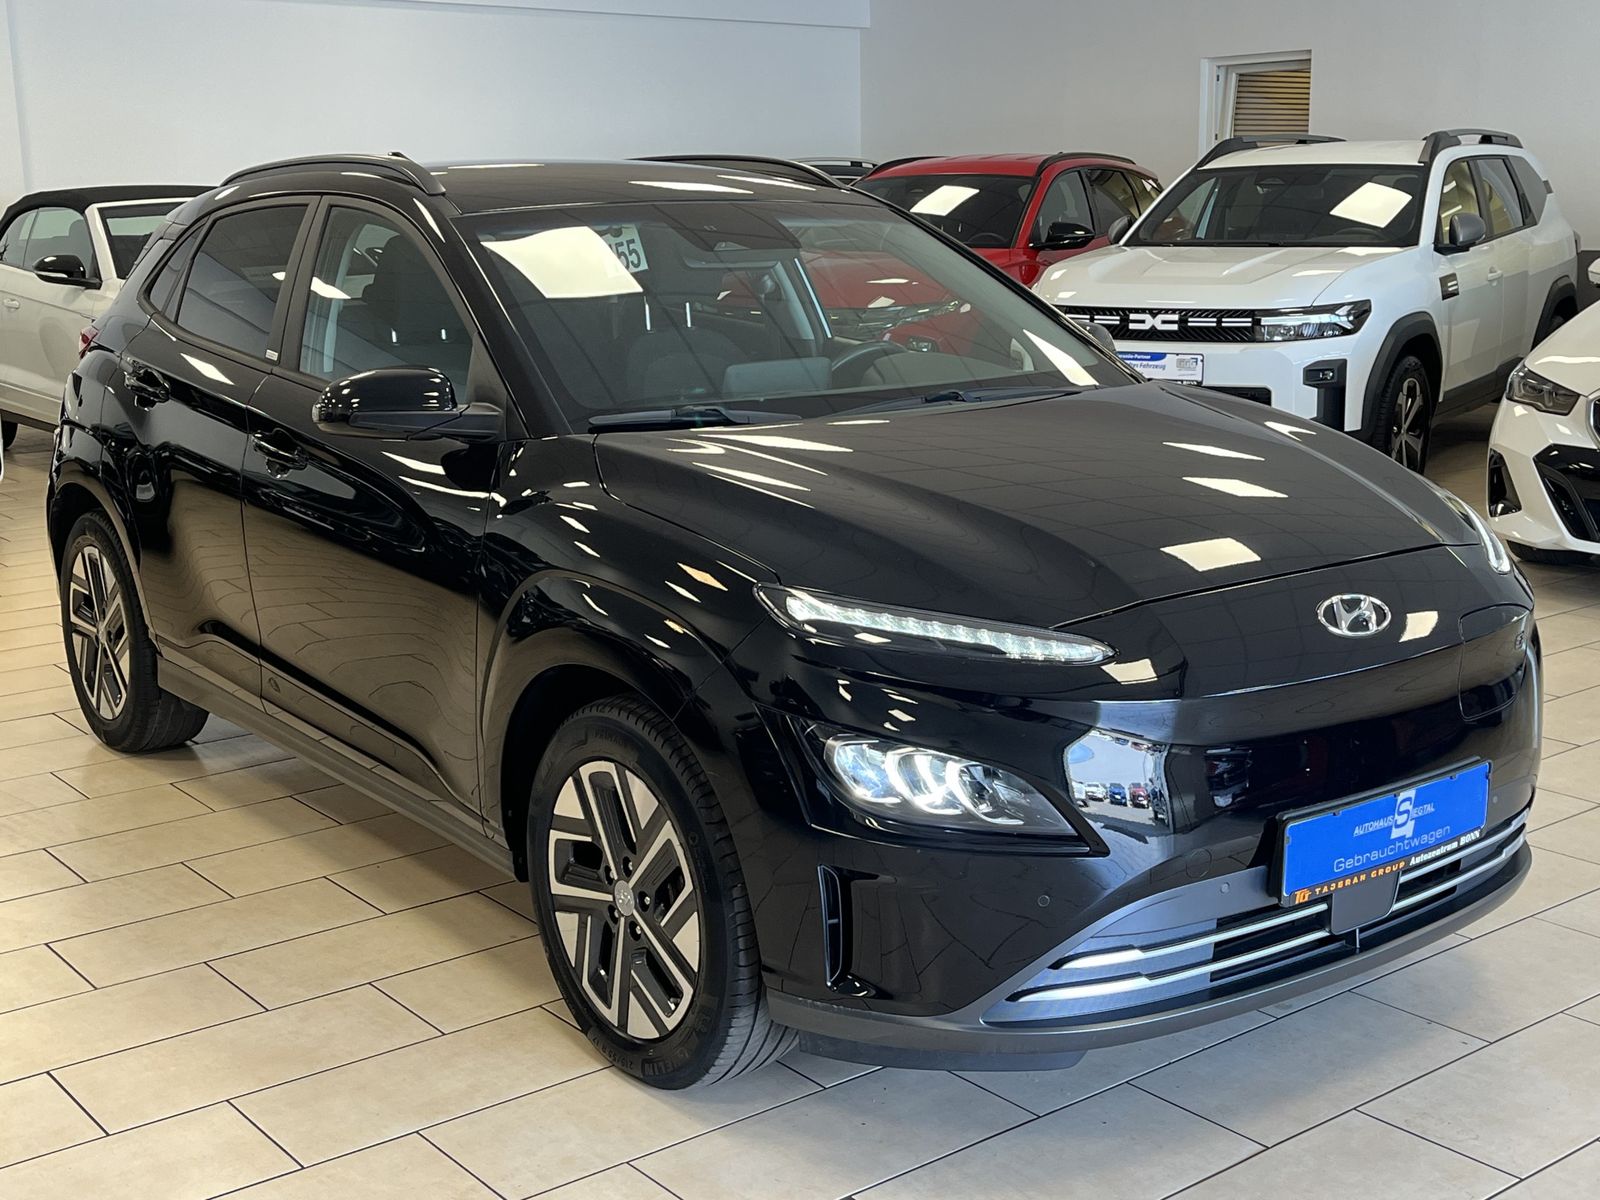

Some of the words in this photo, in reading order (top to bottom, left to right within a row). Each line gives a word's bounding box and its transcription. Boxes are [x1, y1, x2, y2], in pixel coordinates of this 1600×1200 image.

[610, 239, 641, 271] 55
[1352, 815, 1394, 837] AUTOHAUS
[1333, 825, 1451, 873] Gebrauchtwagen
[1370, 861, 1406, 879] GROUP
[1459, 829, 1481, 846] BONN
